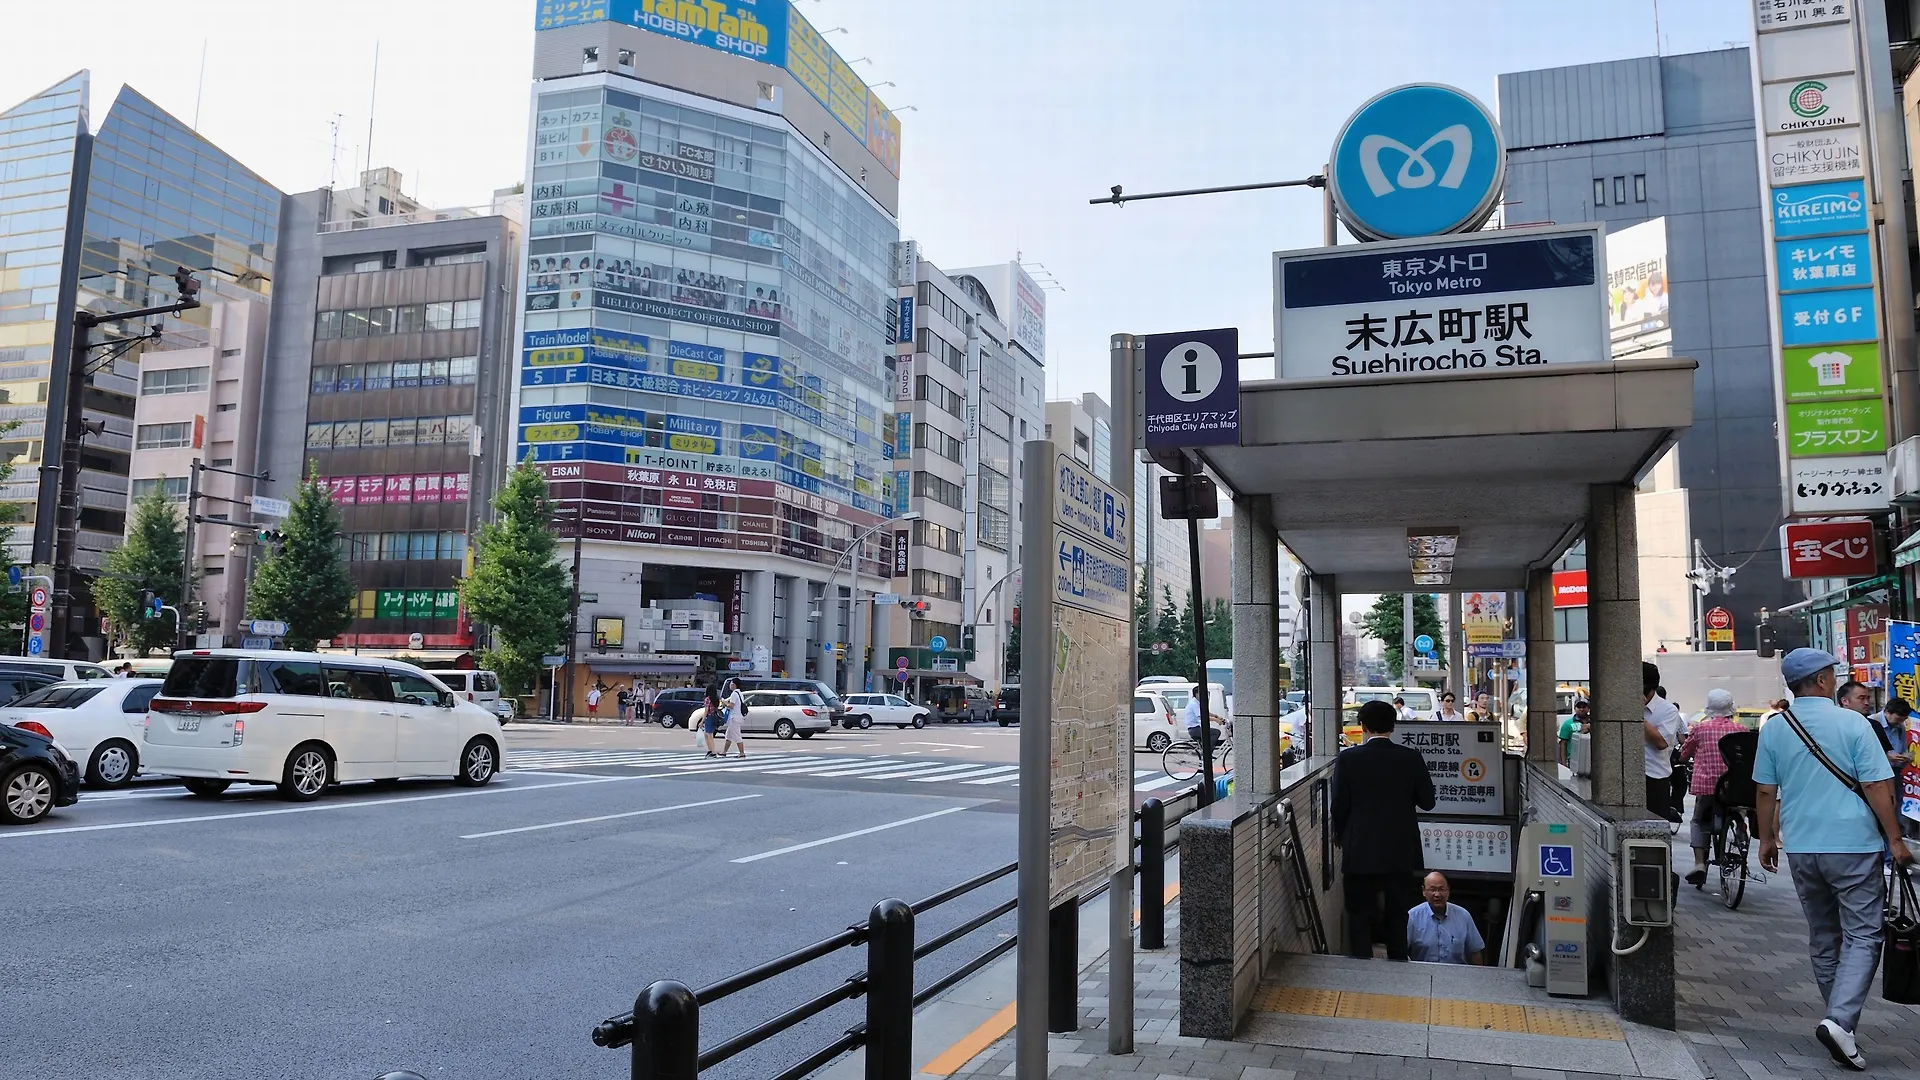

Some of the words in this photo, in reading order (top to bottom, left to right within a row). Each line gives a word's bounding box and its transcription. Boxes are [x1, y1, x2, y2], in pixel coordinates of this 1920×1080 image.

[1775, 4, 1845, 22] 石川興産
[642, 0, 768, 47] TamTam
[634, 10, 704, 39] HOBBY
[715, 33, 768, 57] SHOP
[1781, 117, 1845, 130] CHIKYUJIN
[538, 131, 568, 145] 当ビル
[1788, 137, 1841, 149] 一般財団法人
[679, 145, 714, 163] FC本部
[1772, 145, 1859, 166] CHIKYUJIN
[642, 154, 713, 181] さかい珈琲
[1774, 158, 1861, 178] 留学生支援機構
[537, 184, 563, 199] 内科
[535, 200, 579, 217] 皮膚科
[679, 199, 710, 216] 心療
[1778, 199, 1862, 219] KIREIMO
[679, 216, 709, 233] 内科
[1791, 244, 1855, 263] キレイモ
[1382, 252, 1488, 279] 東京メトロ
[1792, 263, 1856, 281] 秋葉原店
[1389, 278, 1433, 295] Tokyo
[1436, 275, 1482, 291] Metro
[601, 296, 643, 311] HELLO!
[645, 304, 693, 319] PROJECT
[694, 312, 744, 328] OFFICIAL
[745, 320, 774, 332] SHOP
[1345, 302, 1533, 352] 末広町駅
[530, 334, 555, 346] Train
[557, 331, 589, 345] Model
[591, 350, 619, 360] HOBBY
[624, 355, 647, 363] SHOP
[670, 345, 704, 360] DieCast
[708, 351, 723, 362] Car
[1332, 348, 1486, 377] Suehirochō
[1495, 344, 1548, 367] Sta.
[678, 364, 716, 377] ミニカー
[536, 409, 571, 423] Figure
[1147, 409, 1237, 426] 千代田区エリアマップ
[1798, 406, 1871, 418] オリジナルウェア・グッズ
[534, 428, 575, 439] フィギュア
[586, 426, 616, 436] HOBBY
[620, 430, 643, 438] SHOP
[669, 417, 717, 436] Military
[1147, 422, 1180, 433] Chiyoda
[1181, 422, 1197, 432] City
[1199, 421, 1218, 430] Area
[1220, 420, 1237, 430] Map
[675, 437, 712, 450] ミリタリー
[1794, 429, 1878, 447] プラスワン
[645, 455, 698, 470] T-POINT
[552, 466, 580, 477] EISAN
[742, 466, 771, 477] 使える!
[1796, 467, 1883, 478] イージーオーダー紳士服
[304, 475, 456, 493] 古プラモデル高価買取
[627, 469, 660, 484] 秋葉原
[704, 477, 738, 491] 免税店
[587, 507, 617, 516] Panasonic
[810, 495, 823, 511] FREE
[825, 500, 839, 515] SHOP
[666, 514, 696, 523] GUCCI
[742, 521, 769, 529] CHANEL
[586, 527, 615, 535] SONY
[626, 529, 656, 540] Nikon
[667, 533, 693, 542] Canon
[704, 536, 732, 544] HITACHI
[741, 539, 769, 547] TOSHIBA
[1793, 536, 1869, 563] 宝くじ
[1858, 608, 1879, 633] 宝くじ
[1402, 732, 1460, 747] 末広町駅
[1483, 733, 1489, 742] 1
[1448, 747, 1463, 755] Sta.
[1427, 760, 1460, 772] 銀座線
[1468, 769, 1480, 778] 14
[1469, 762, 1477, 770] G
[1440, 785, 1495, 797] 渋谷方面専用
[1440, 795, 1459, 803] Ginza,
[1460, 796, 1486, 804] Shibuya
